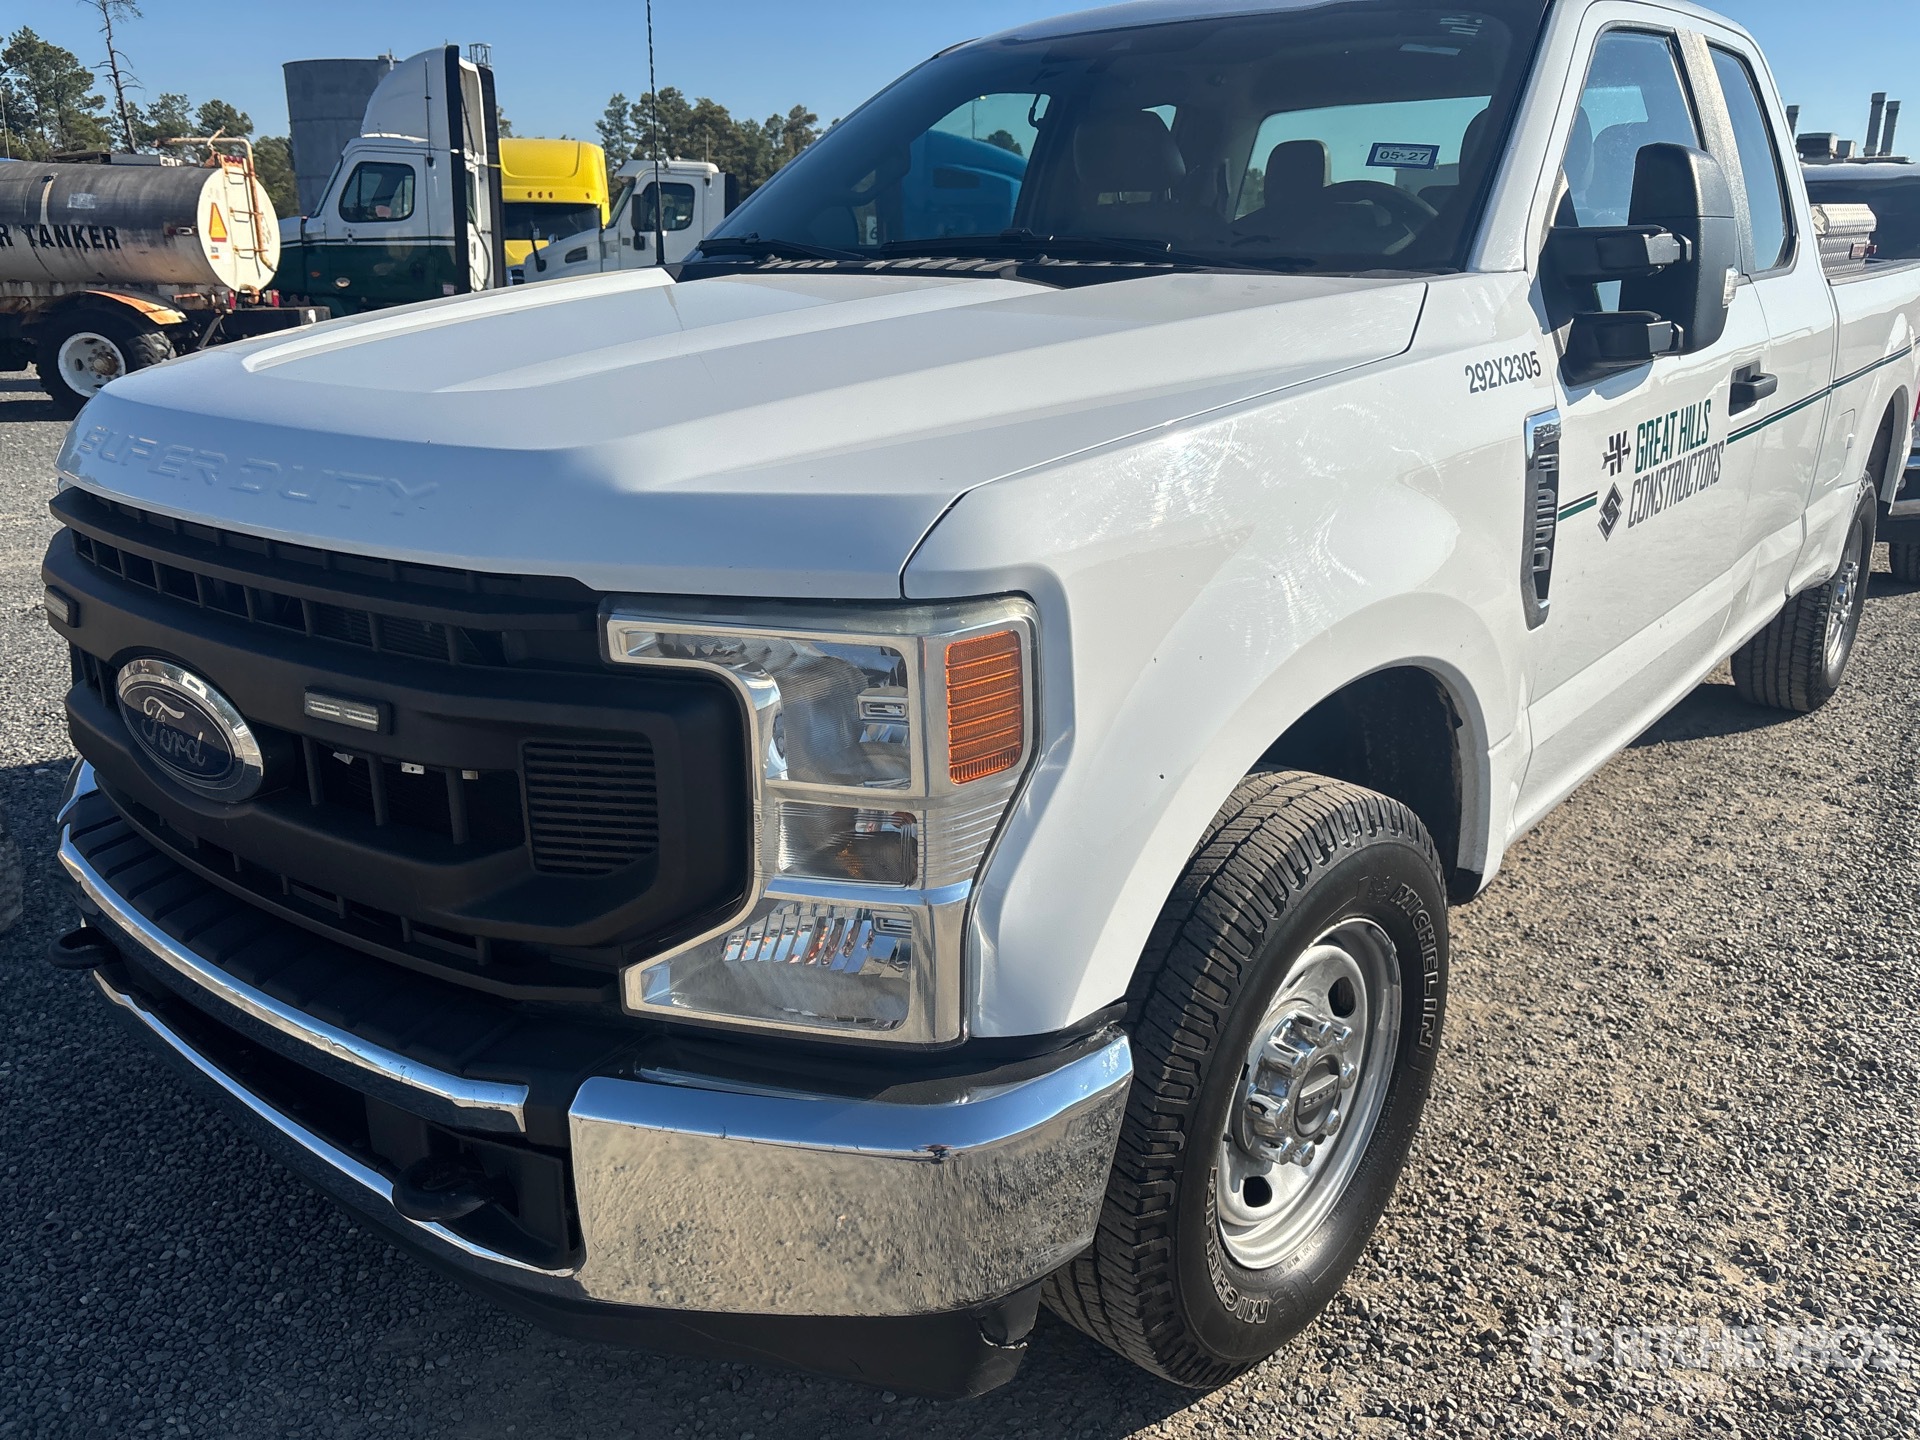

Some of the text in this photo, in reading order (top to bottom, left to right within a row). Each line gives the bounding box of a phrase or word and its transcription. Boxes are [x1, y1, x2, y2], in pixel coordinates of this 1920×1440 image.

[20, 223, 121, 251] TANKER
[1464, 350, 1542, 394] 292X2305
[1634, 398, 1712, 475] GREAT HILLS
[228, 457, 440, 517] DUTY
[1627, 439, 1725, 529] CONSTRUCTORS
[140, 695, 206, 767] Ford
[1389, 882, 1439, 1049] MICHELIN
[1205, 1166, 1270, 1325] MICHELIN
